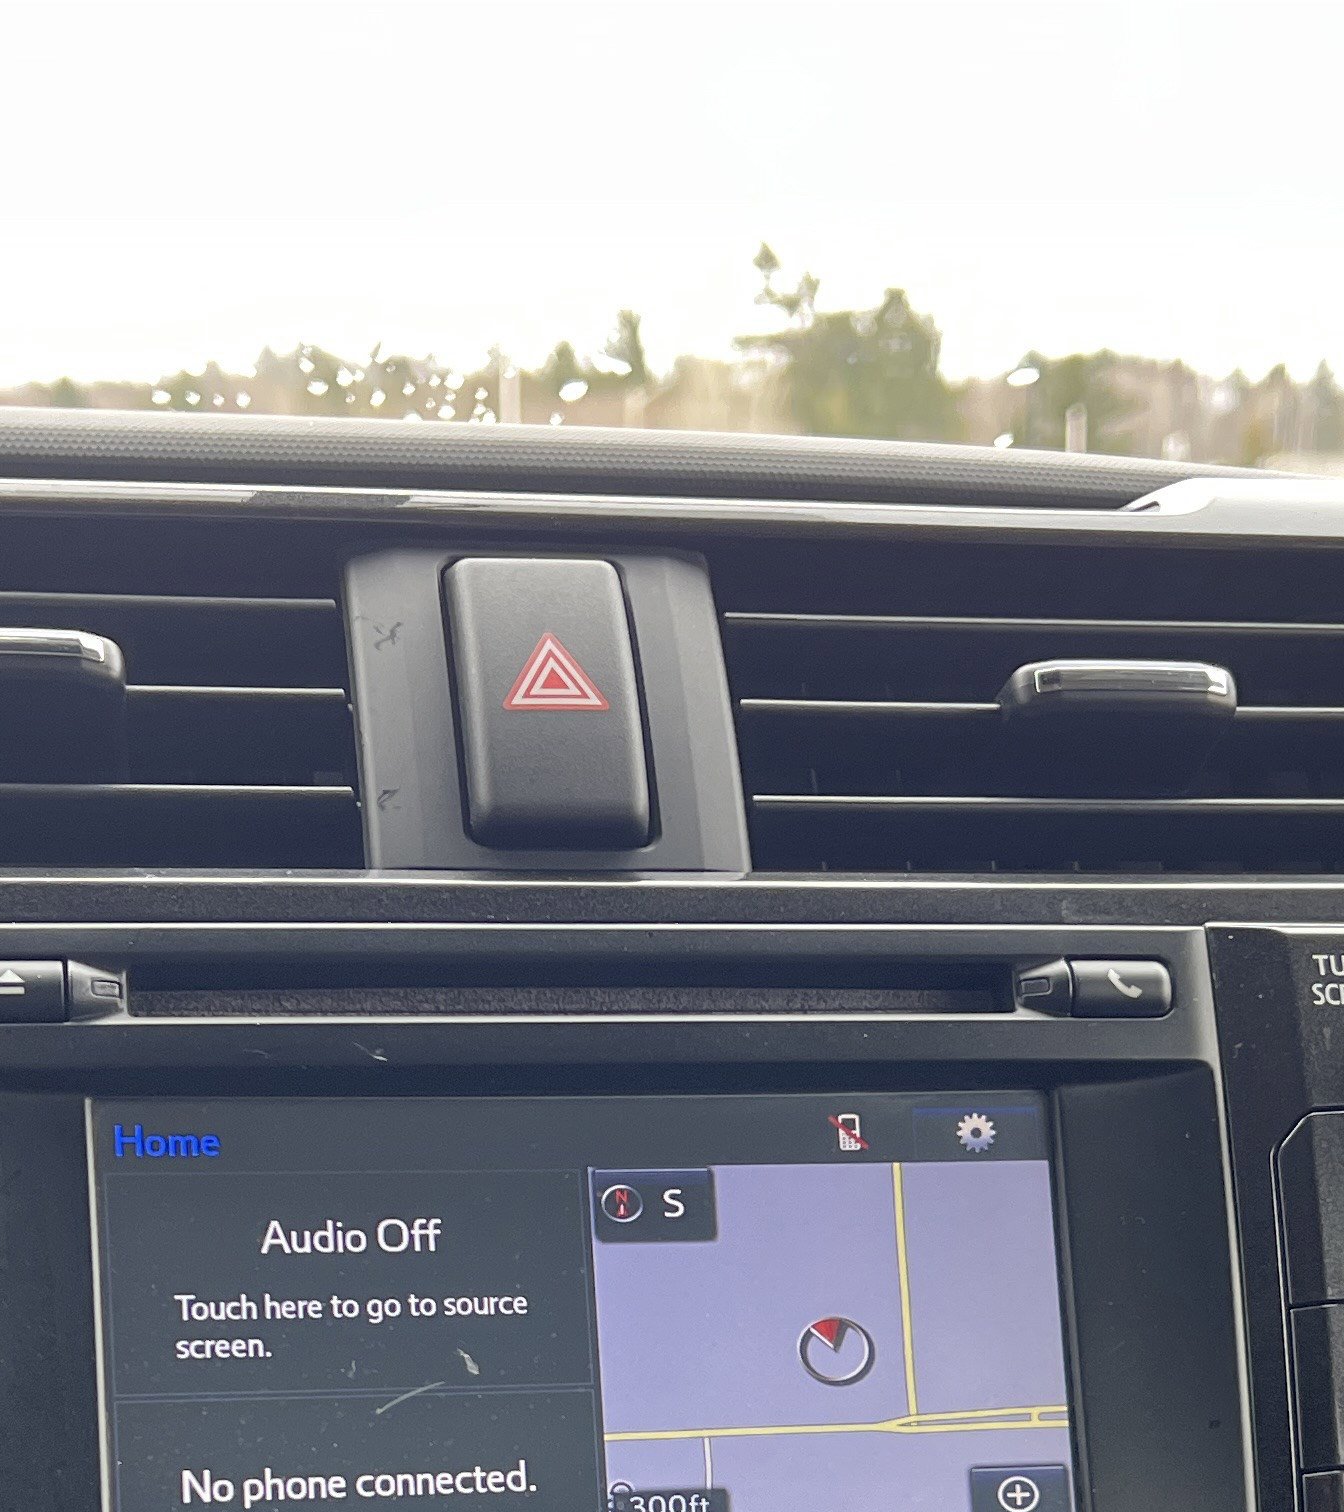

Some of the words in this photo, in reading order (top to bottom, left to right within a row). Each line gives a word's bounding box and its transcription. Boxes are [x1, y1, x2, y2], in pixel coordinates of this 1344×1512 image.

[113, 1124, 221, 1158] Home
[663, 1188, 685, 1218] S
[260, 1219, 367, 1254] Audio
[377, 1217, 443, 1252] Off
[174, 1293, 258, 1321] Touch
[263, 1292, 323, 1320] here
[330, 1295, 360, 1319] to
[366, 1298, 400, 1324] go
[408, 1294, 437, 1317] to
[443, 1294, 529, 1318] source
[174, 1336, 273, 1359] screen.
[180, 1469, 235, 1504] No
[243, 1467, 348, 1509] phone
[355, 1460, 538, 1499] connected.
